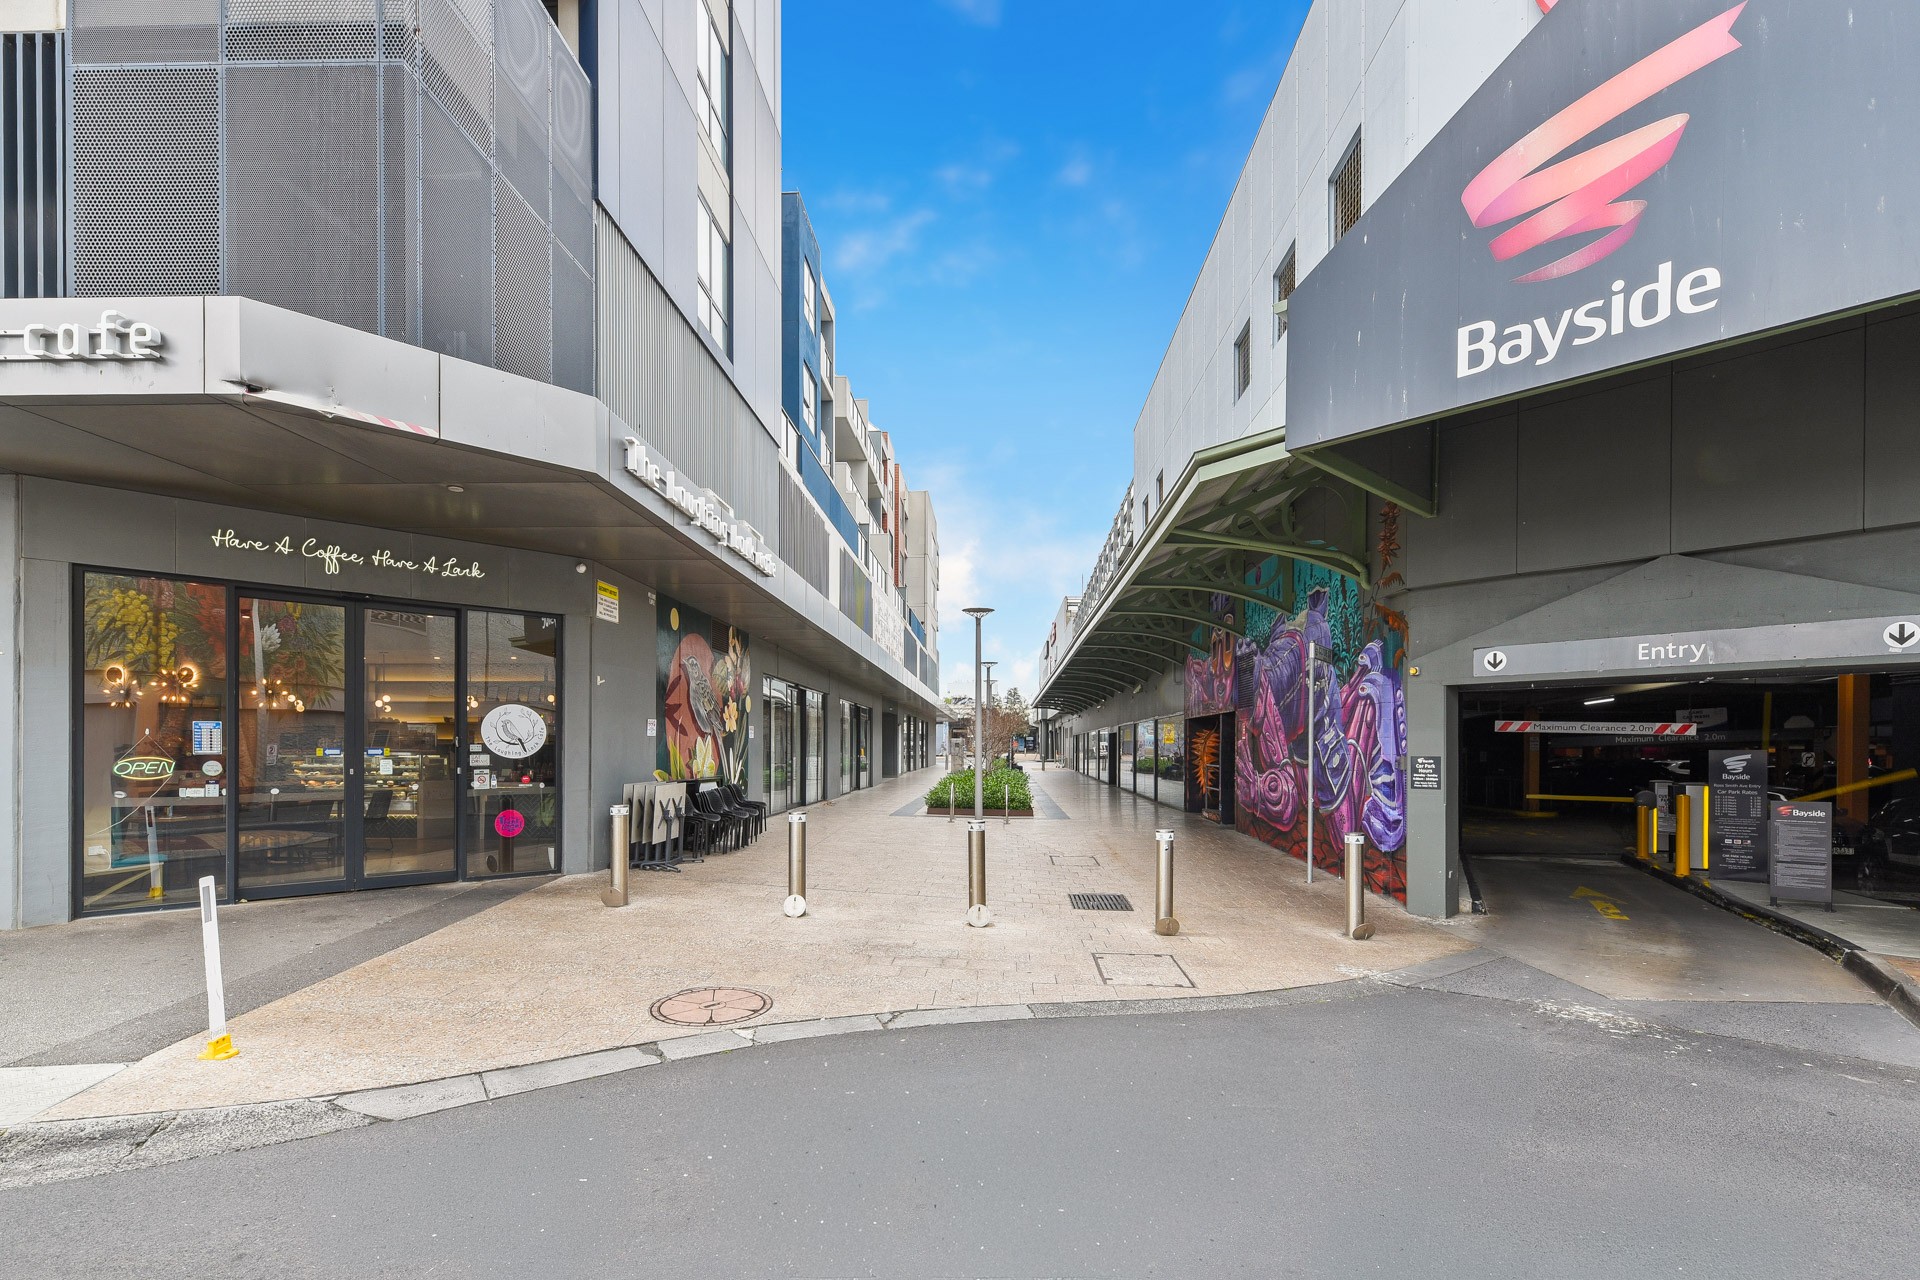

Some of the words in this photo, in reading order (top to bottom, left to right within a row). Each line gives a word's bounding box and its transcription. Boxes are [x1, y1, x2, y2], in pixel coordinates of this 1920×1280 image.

[1456, 260, 1722, 379] Bayside
[24, 309, 160, 356] cafe
[625, 436, 660, 488] The
[212, 529, 269, 551] Have
[275, 536, 293, 555] A
[302, 538, 363, 574] Coffee,
[372, 550, 418, 570] Have
[423, 556, 438, 573] A
[442, 558, 485, 578] Lark
[1638, 642, 1706, 663] Entry
[1533, 723, 1578, 731] Maximum
[1580, 723, 1626, 732] Clearance
[1630, 724, 1654, 732] 2.0m
[1658, 734, 1699, 742] Clearance
[113, 761, 176, 776] OPEN
[1792, 809, 1826, 818] Bayside
